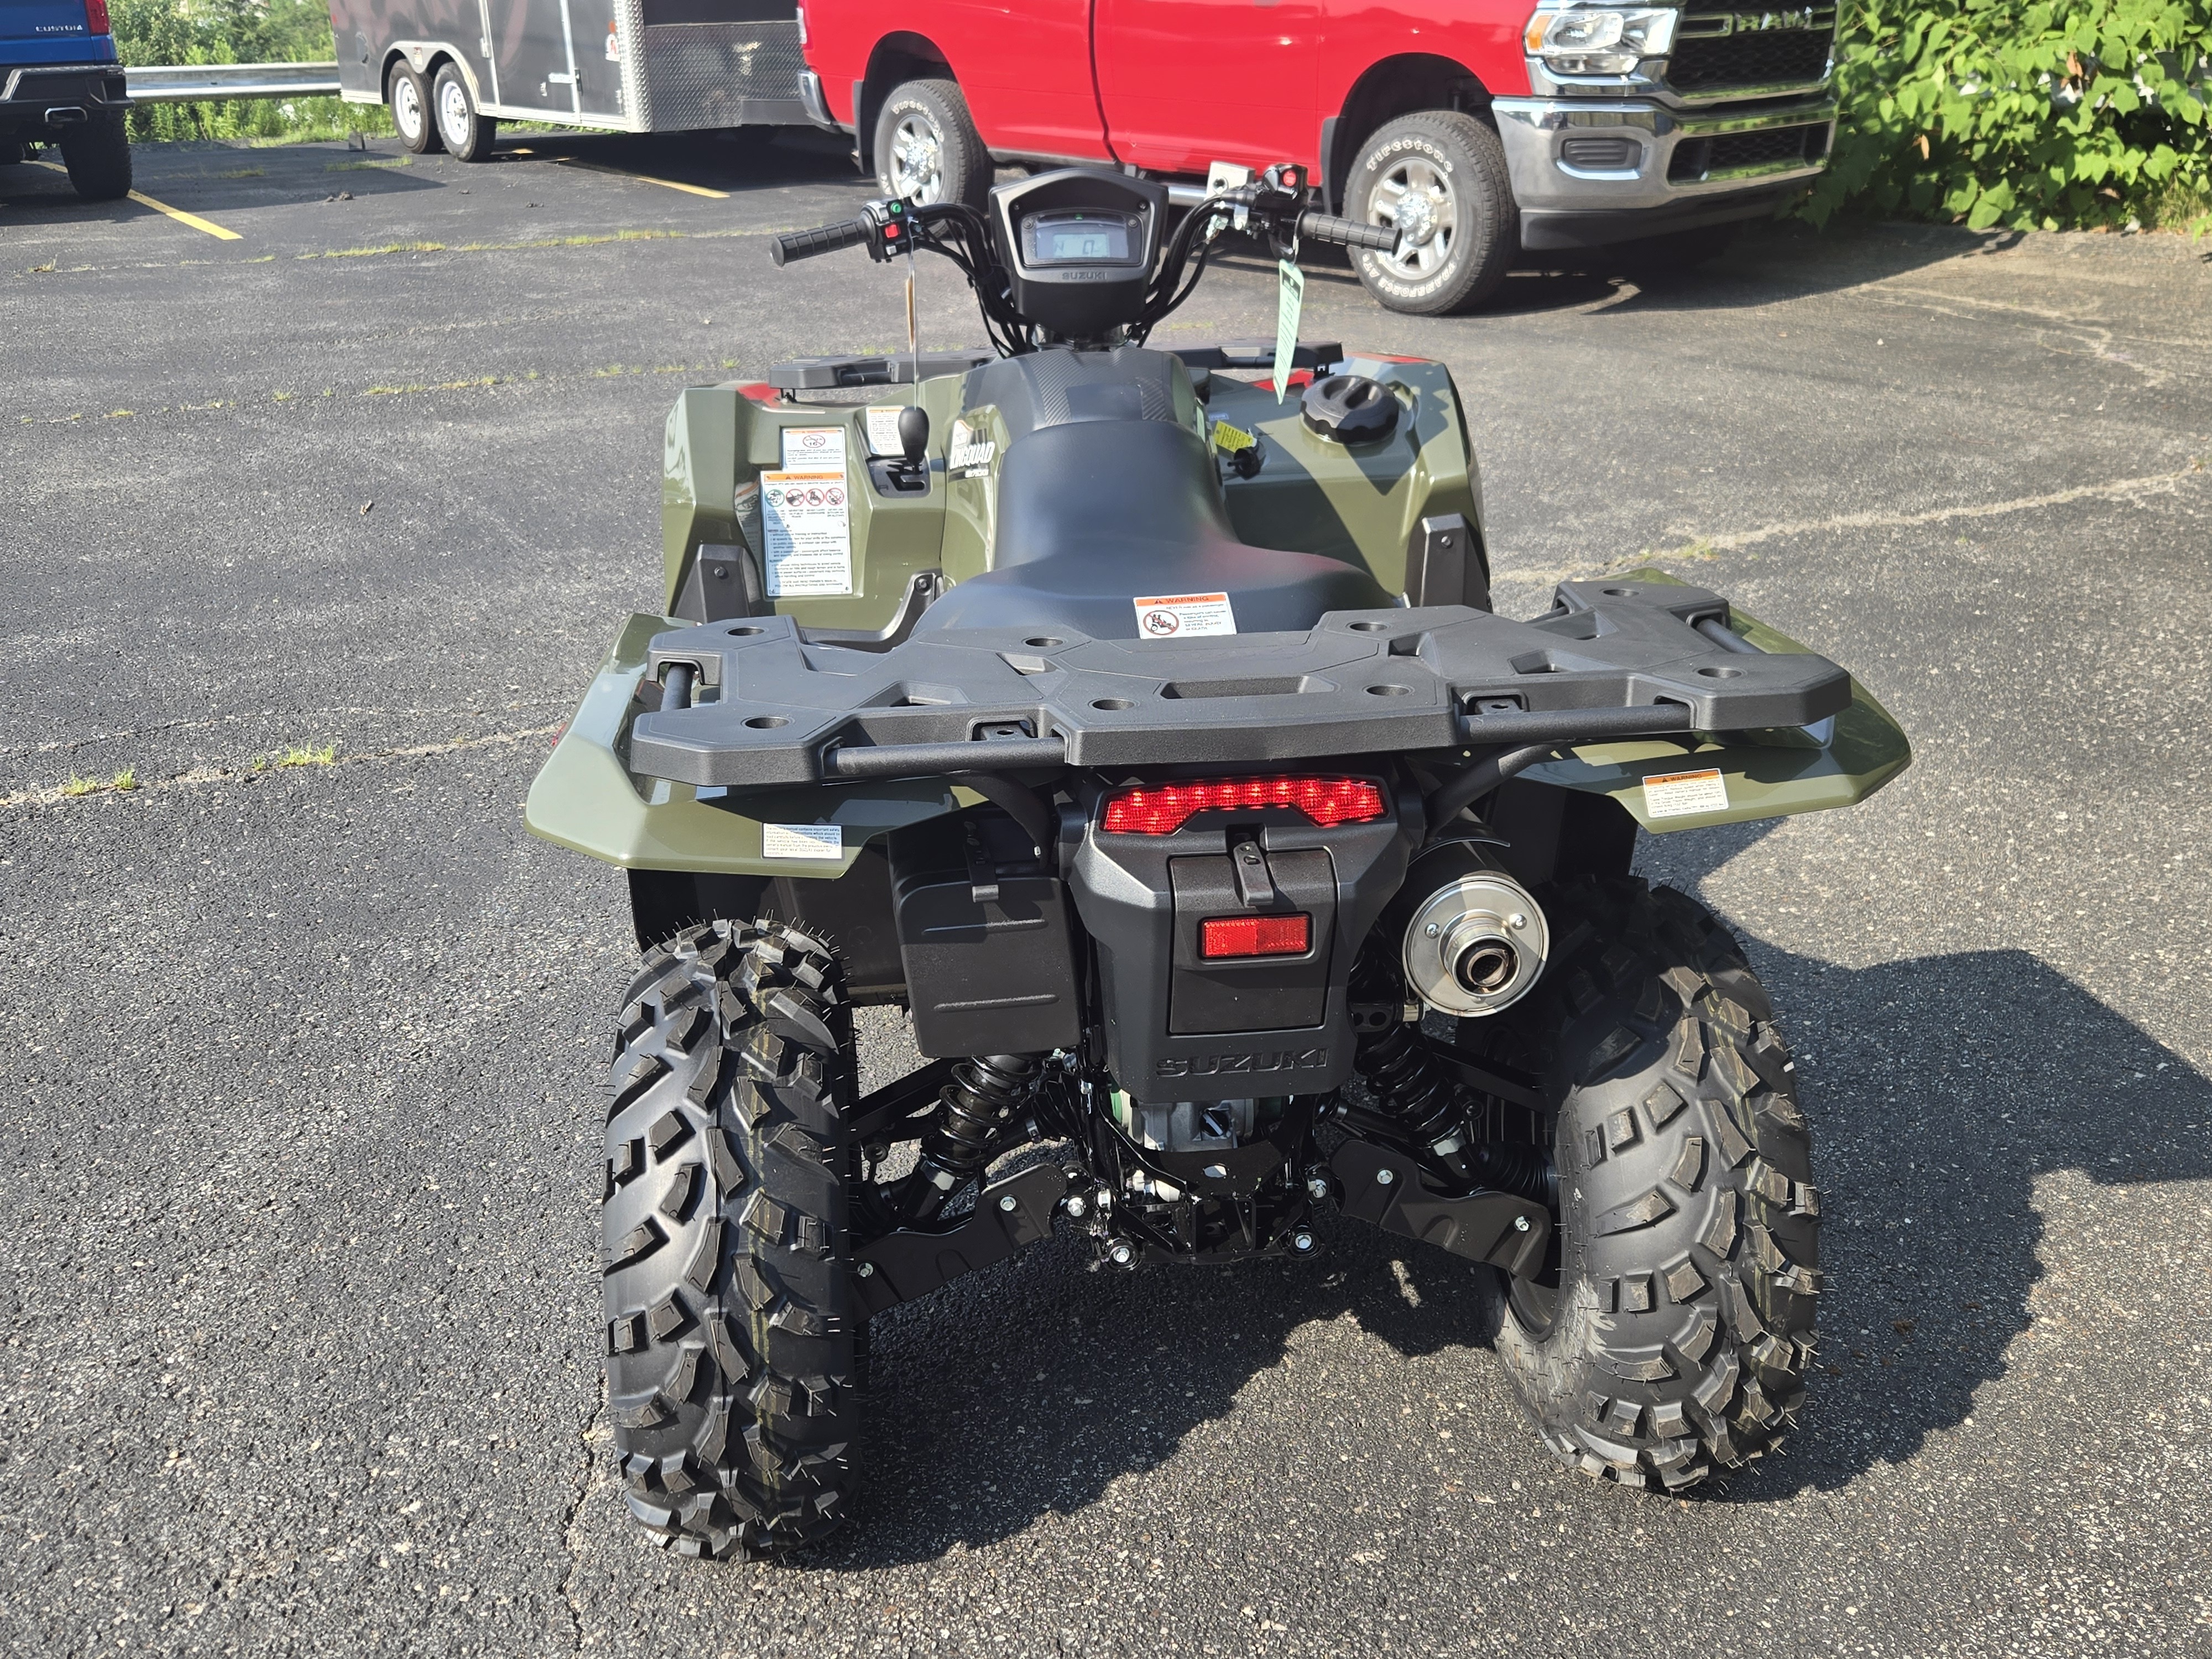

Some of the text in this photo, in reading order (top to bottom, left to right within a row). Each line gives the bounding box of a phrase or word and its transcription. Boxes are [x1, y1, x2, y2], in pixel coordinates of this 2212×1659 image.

[1735, 7, 1811, 32] RAM
[1062, 272, 1108, 280] SUZUKI
[1166, 596, 1209, 604] WARNING
[1156, 1048, 1328, 1078] SUZUKI
